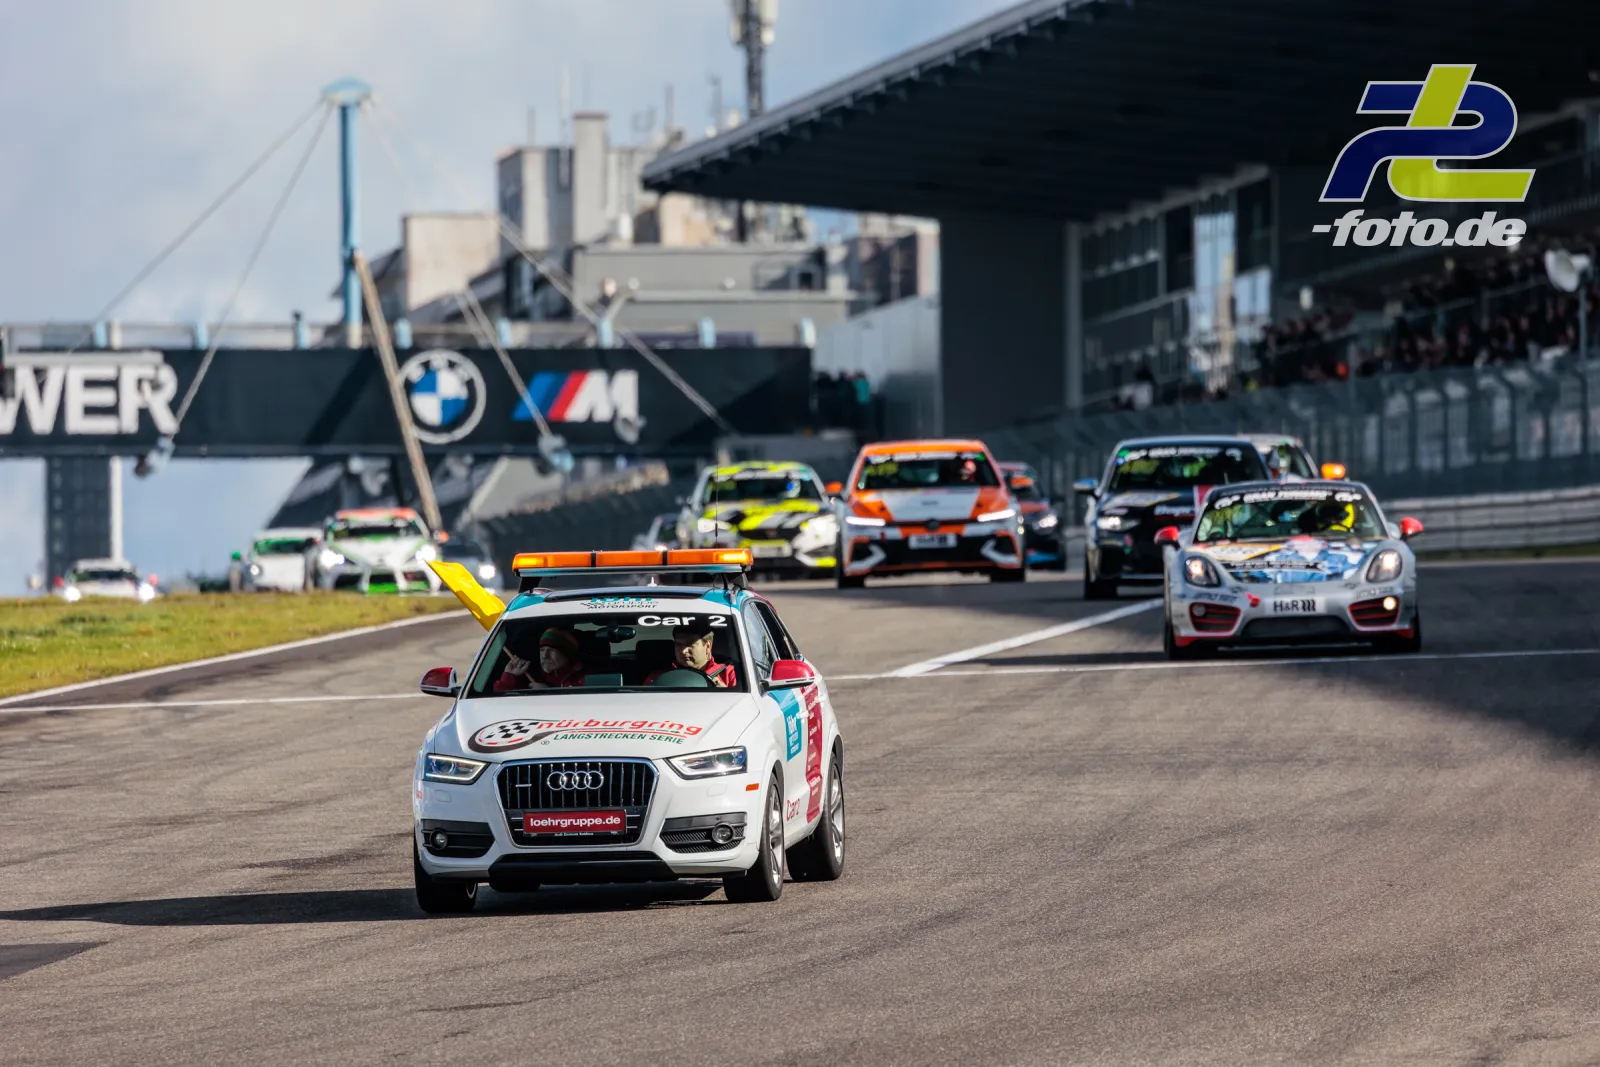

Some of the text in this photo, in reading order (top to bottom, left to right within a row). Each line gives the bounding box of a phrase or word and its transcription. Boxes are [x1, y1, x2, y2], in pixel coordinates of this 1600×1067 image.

[1273, 599, 1299, 613] H&R
[637, 615, 728, 627] Car 2
[536, 718, 703, 736] nürburgring
[553, 731, 684, 745] LANGSTRECKEN SERIE
[529, 815, 621, 828] loehrgruppe.de
